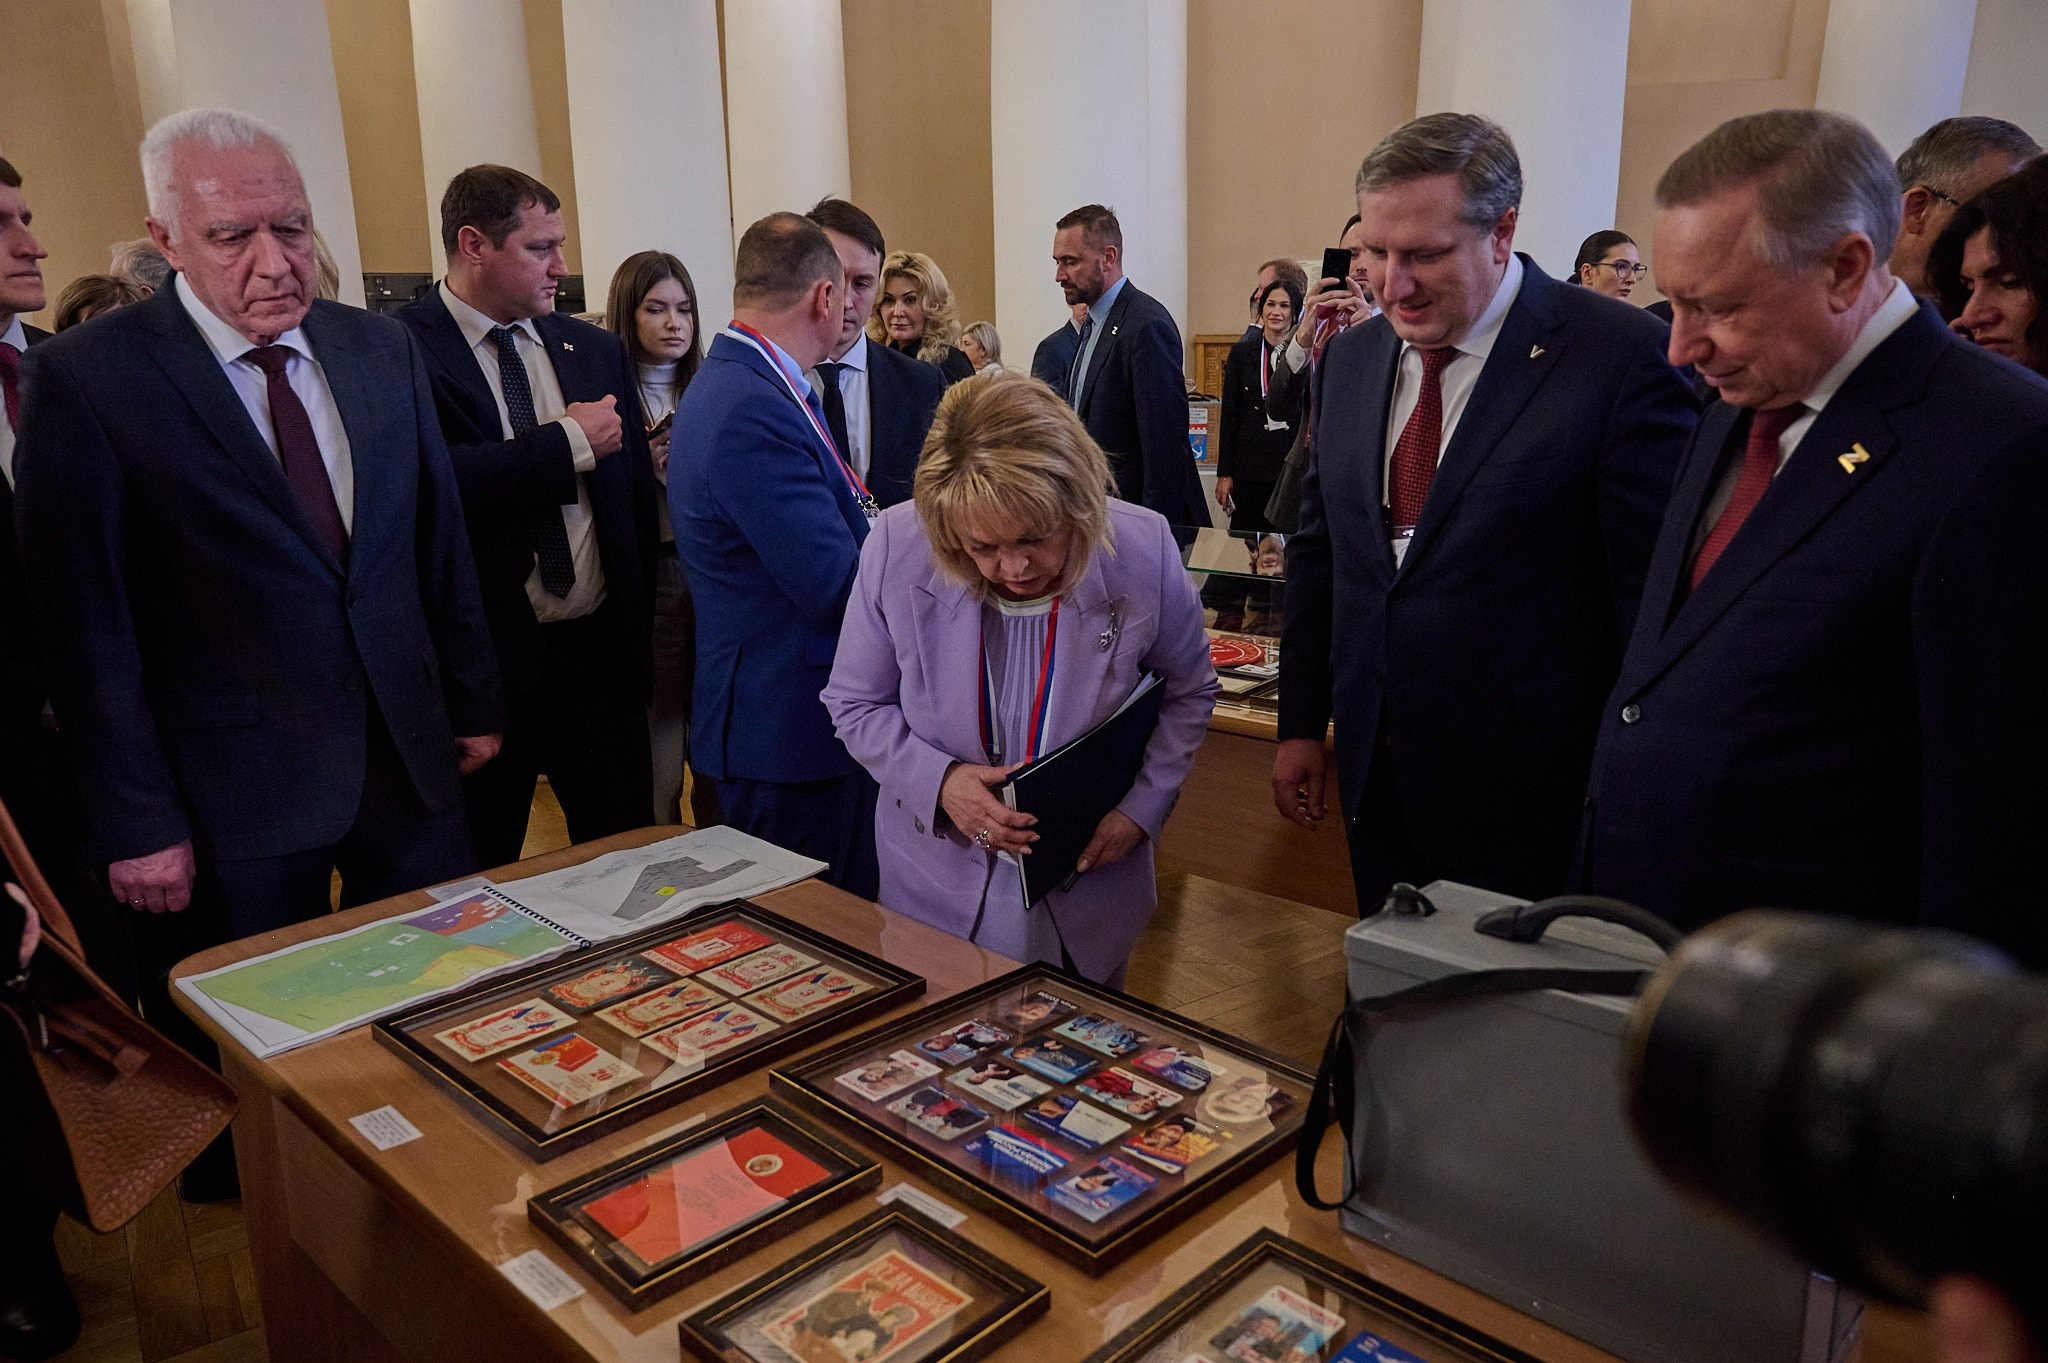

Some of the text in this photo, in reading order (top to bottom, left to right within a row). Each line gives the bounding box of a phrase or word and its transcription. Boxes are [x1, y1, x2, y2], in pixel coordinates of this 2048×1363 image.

[1837, 442, 1871, 475] Z
[701, 940, 725, 951] 17
[754, 961, 775, 972] 22
[799, 989, 814, 997] 3
[653, 1002, 669, 1010] 14
[699, 1027, 715, 1036] 16
[590, 1068, 612, 1081] 20
